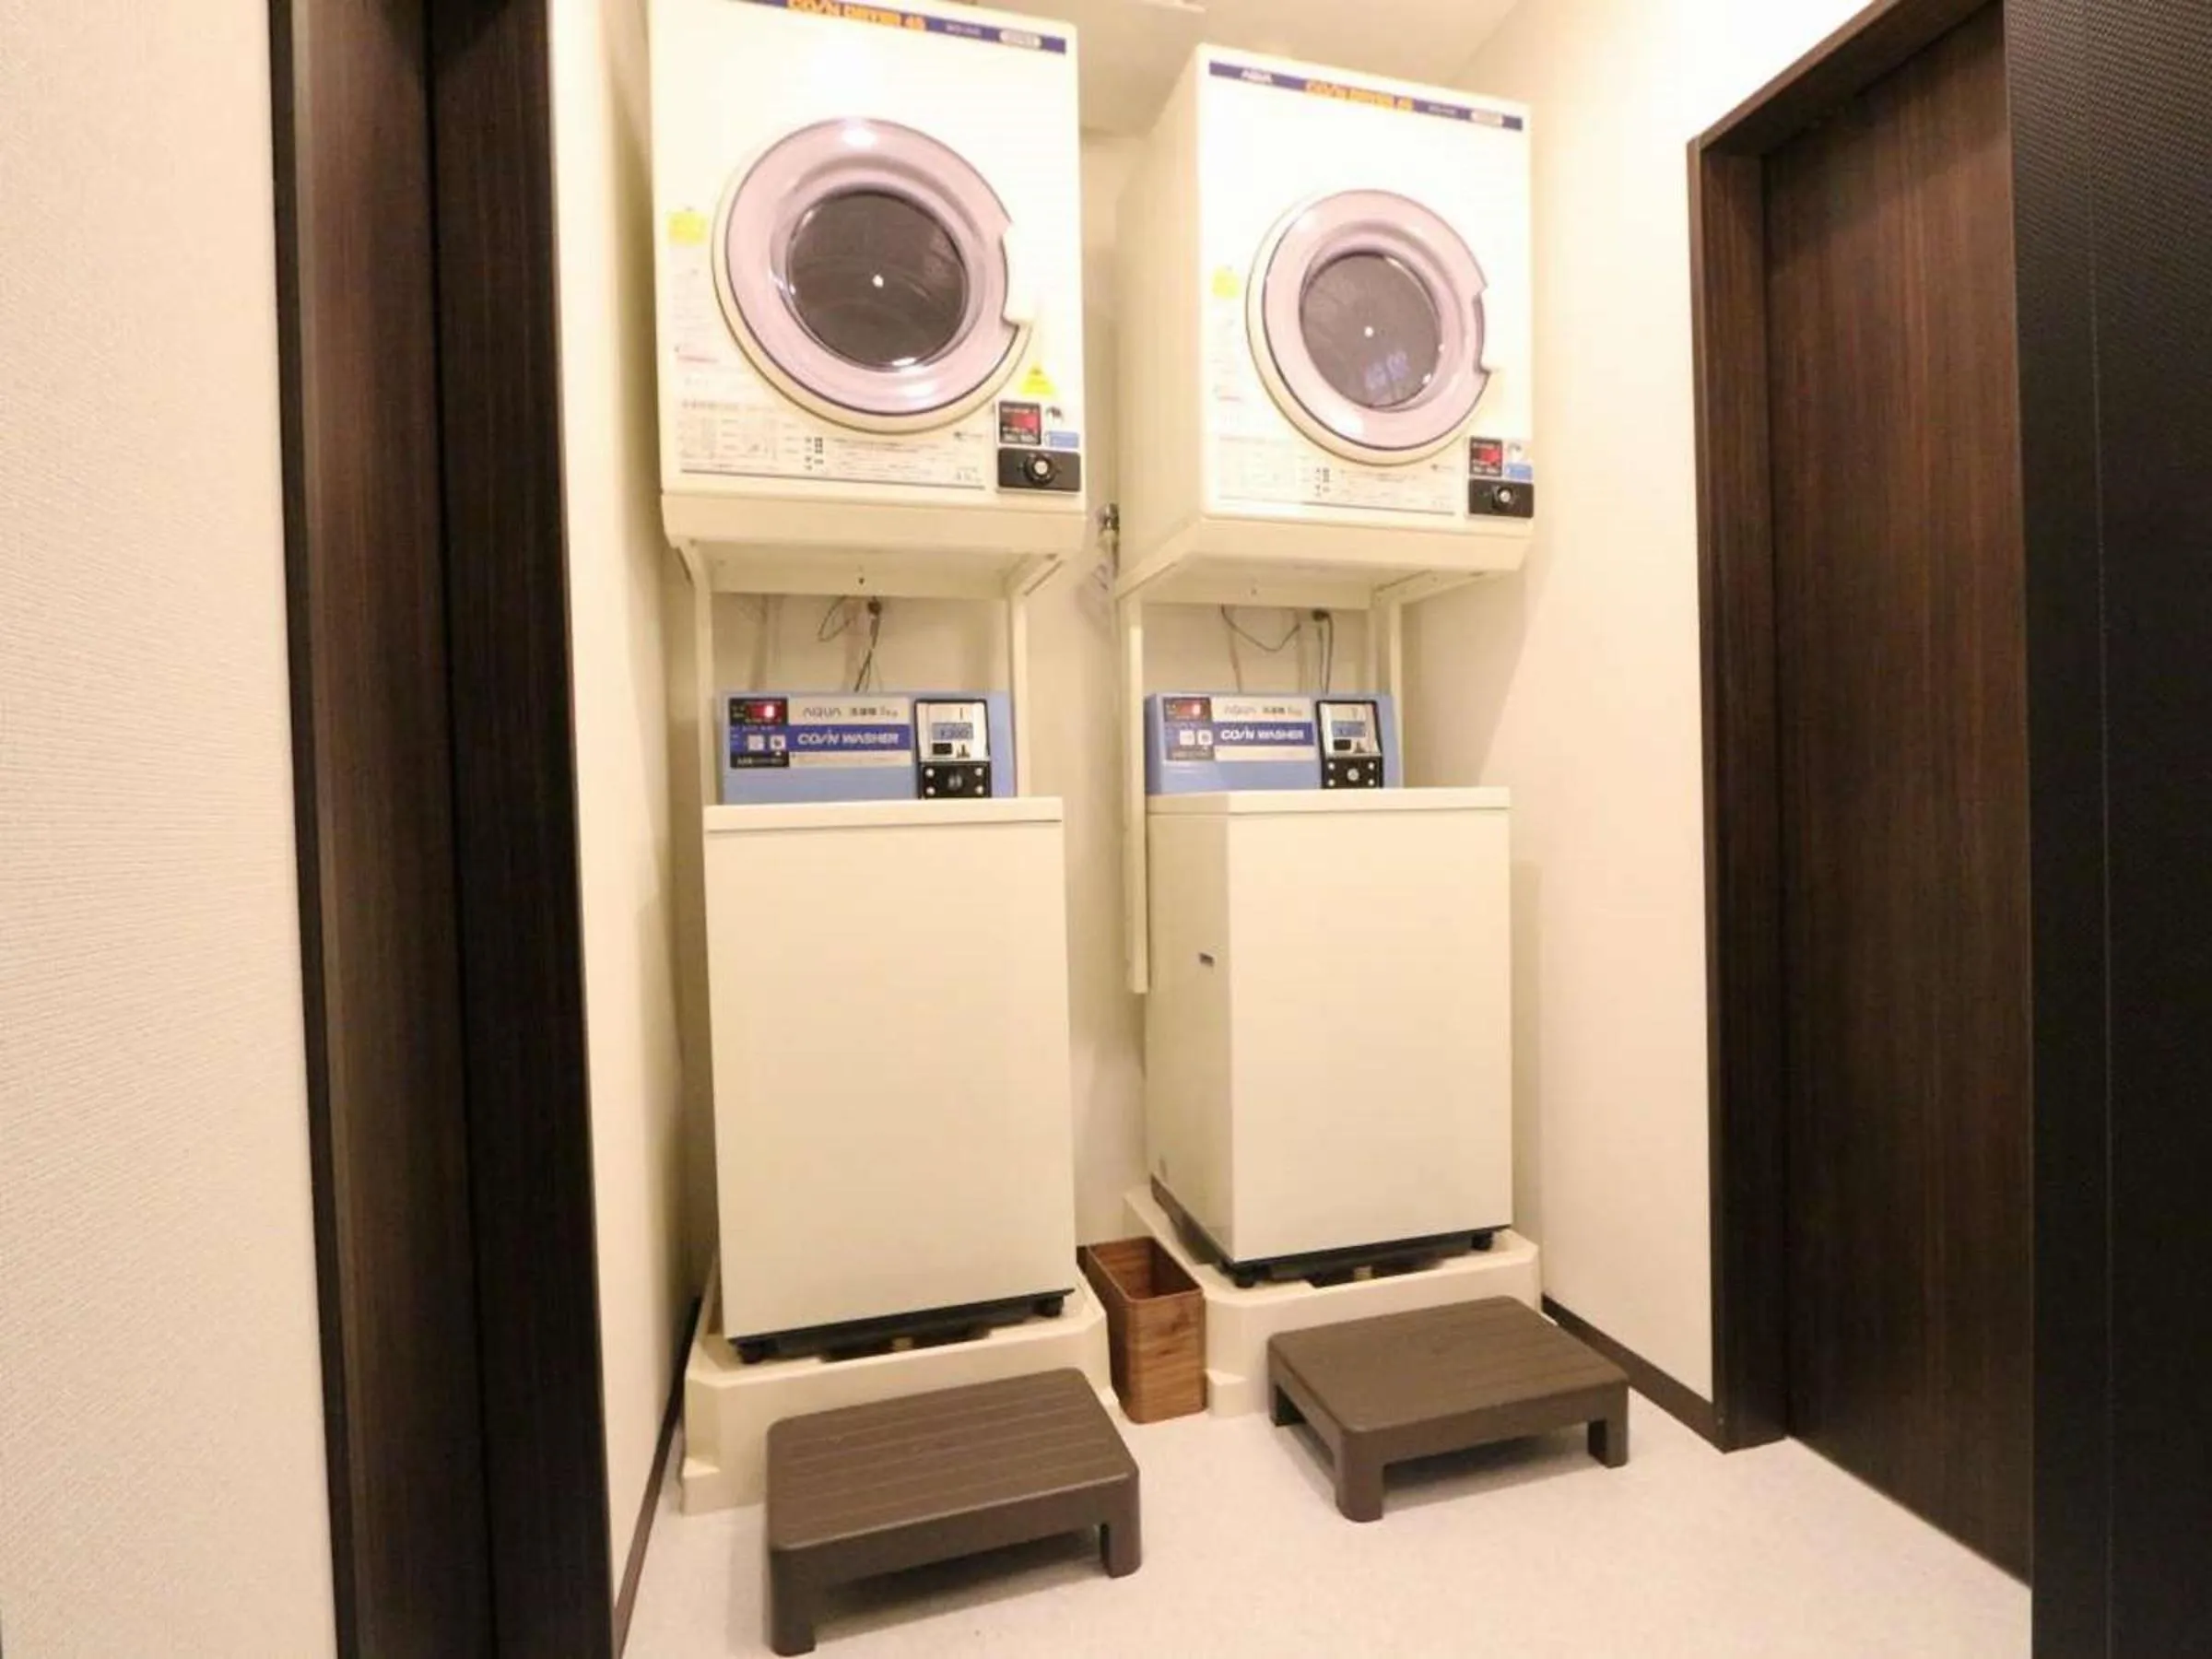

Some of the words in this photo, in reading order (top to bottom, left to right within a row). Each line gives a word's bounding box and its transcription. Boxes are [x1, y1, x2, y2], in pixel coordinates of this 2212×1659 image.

[803, 707, 842, 718] AQUA
[797, 729, 841, 746] COIN
[841, 733, 900, 745] WASHER
[1220, 725, 1254, 741] COIN
[1256, 729, 1304, 741] WASHER
